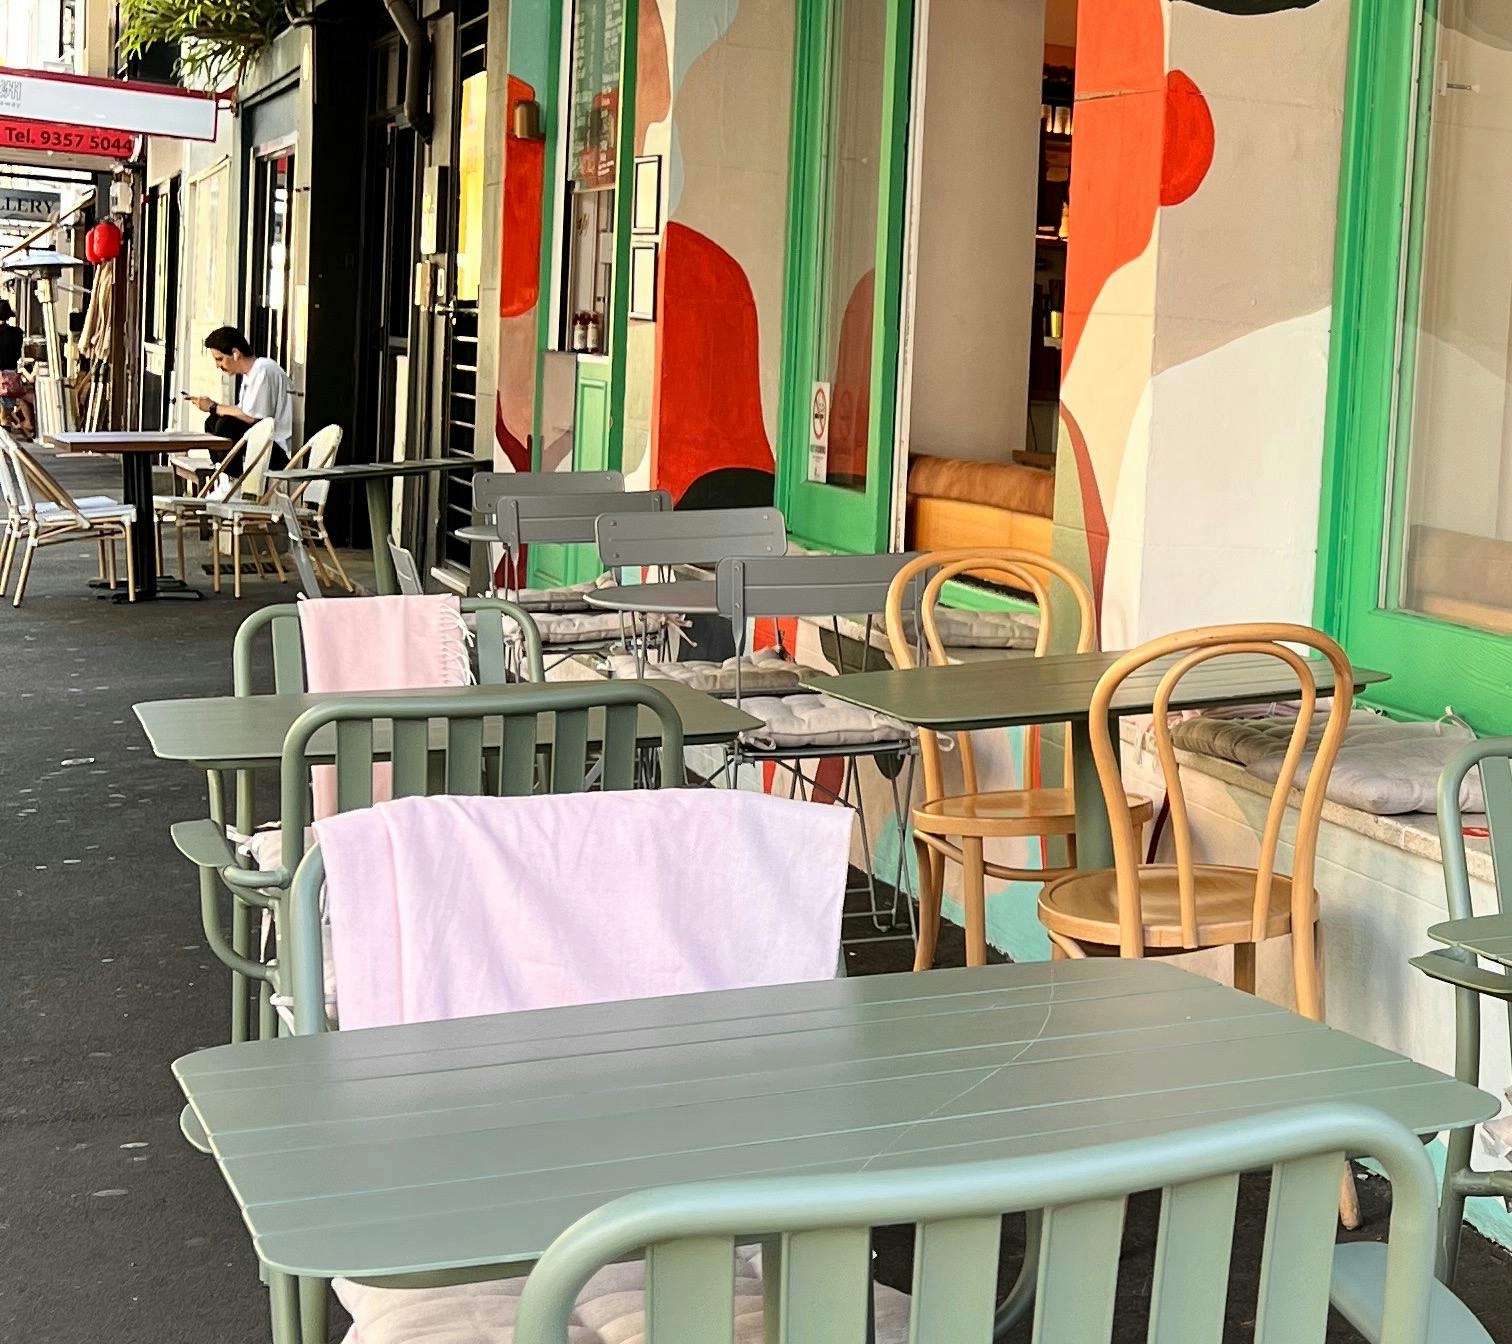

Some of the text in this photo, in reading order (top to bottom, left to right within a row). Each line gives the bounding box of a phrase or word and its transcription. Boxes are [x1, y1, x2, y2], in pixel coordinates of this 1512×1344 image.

[5, 127, 133, 152] Tel. 9357 5044
